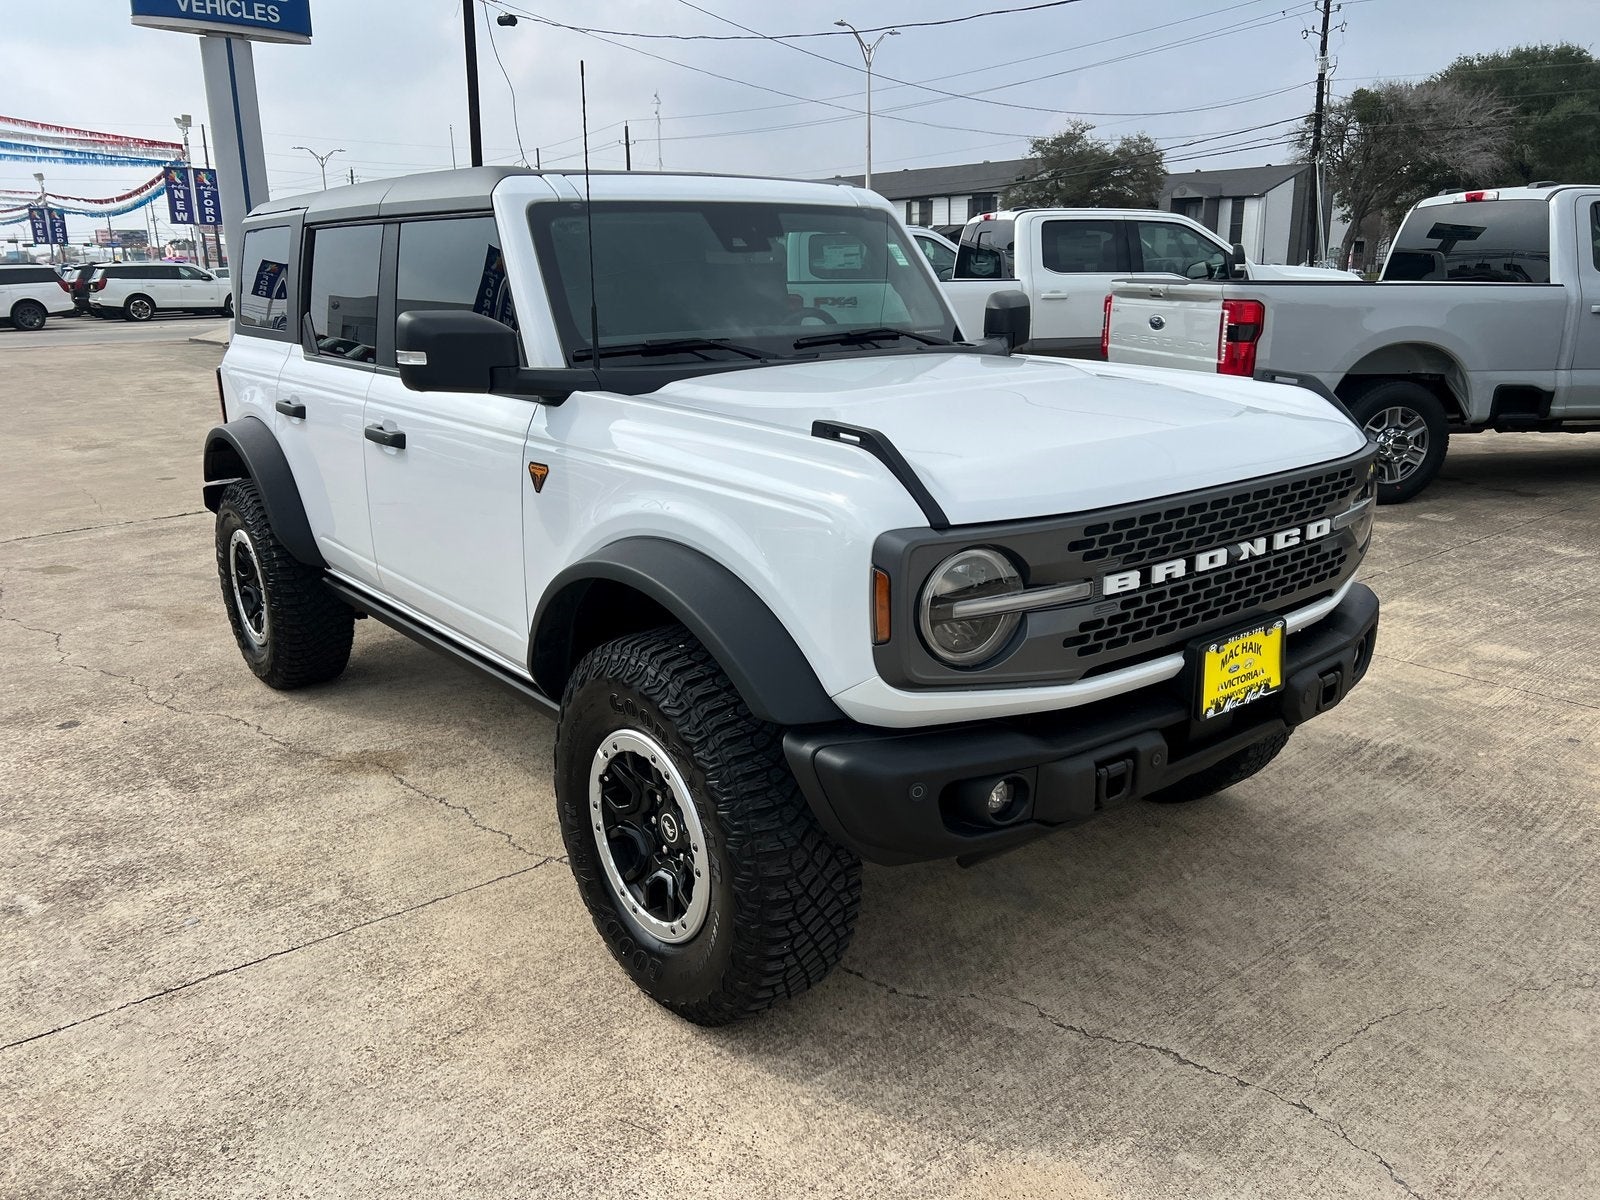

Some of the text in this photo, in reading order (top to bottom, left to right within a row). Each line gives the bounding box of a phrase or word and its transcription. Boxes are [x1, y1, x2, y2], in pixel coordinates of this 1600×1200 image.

[176, 0, 281, 23] VEHICLES
[173, 189, 188, 222] NEW
[203, 190, 216, 223] FORD
[35, 222, 46, 243] NEW
[55, 222, 64, 243] FORD
[1102, 518, 1331, 596] BRONCO
[1220, 644, 1240, 671] MAC
[1241, 641, 1262, 656] HAIK
